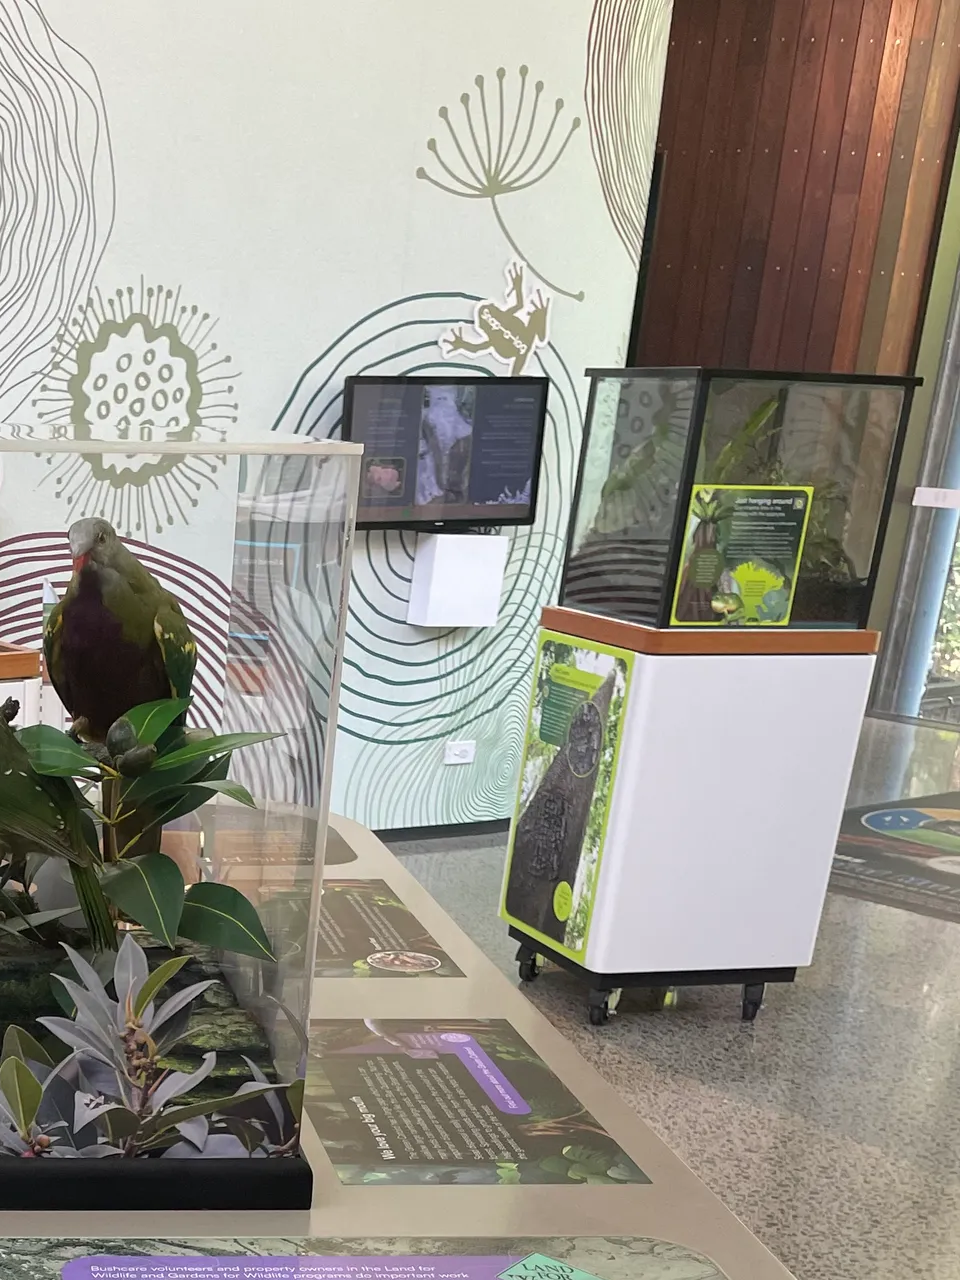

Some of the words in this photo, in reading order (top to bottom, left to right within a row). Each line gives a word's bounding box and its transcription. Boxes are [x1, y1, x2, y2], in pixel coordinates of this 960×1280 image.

[349, 1096, 369, 1113] mouth
[360, 1114, 375, 1123] big
[368, 1124, 387, 1136] your
[376, 1137, 390, 1149] love
[380, 1150, 396, 1160] We
[522, 1263, 575, 1274] LAND
[536, 1272, 574, 1280] FOR
